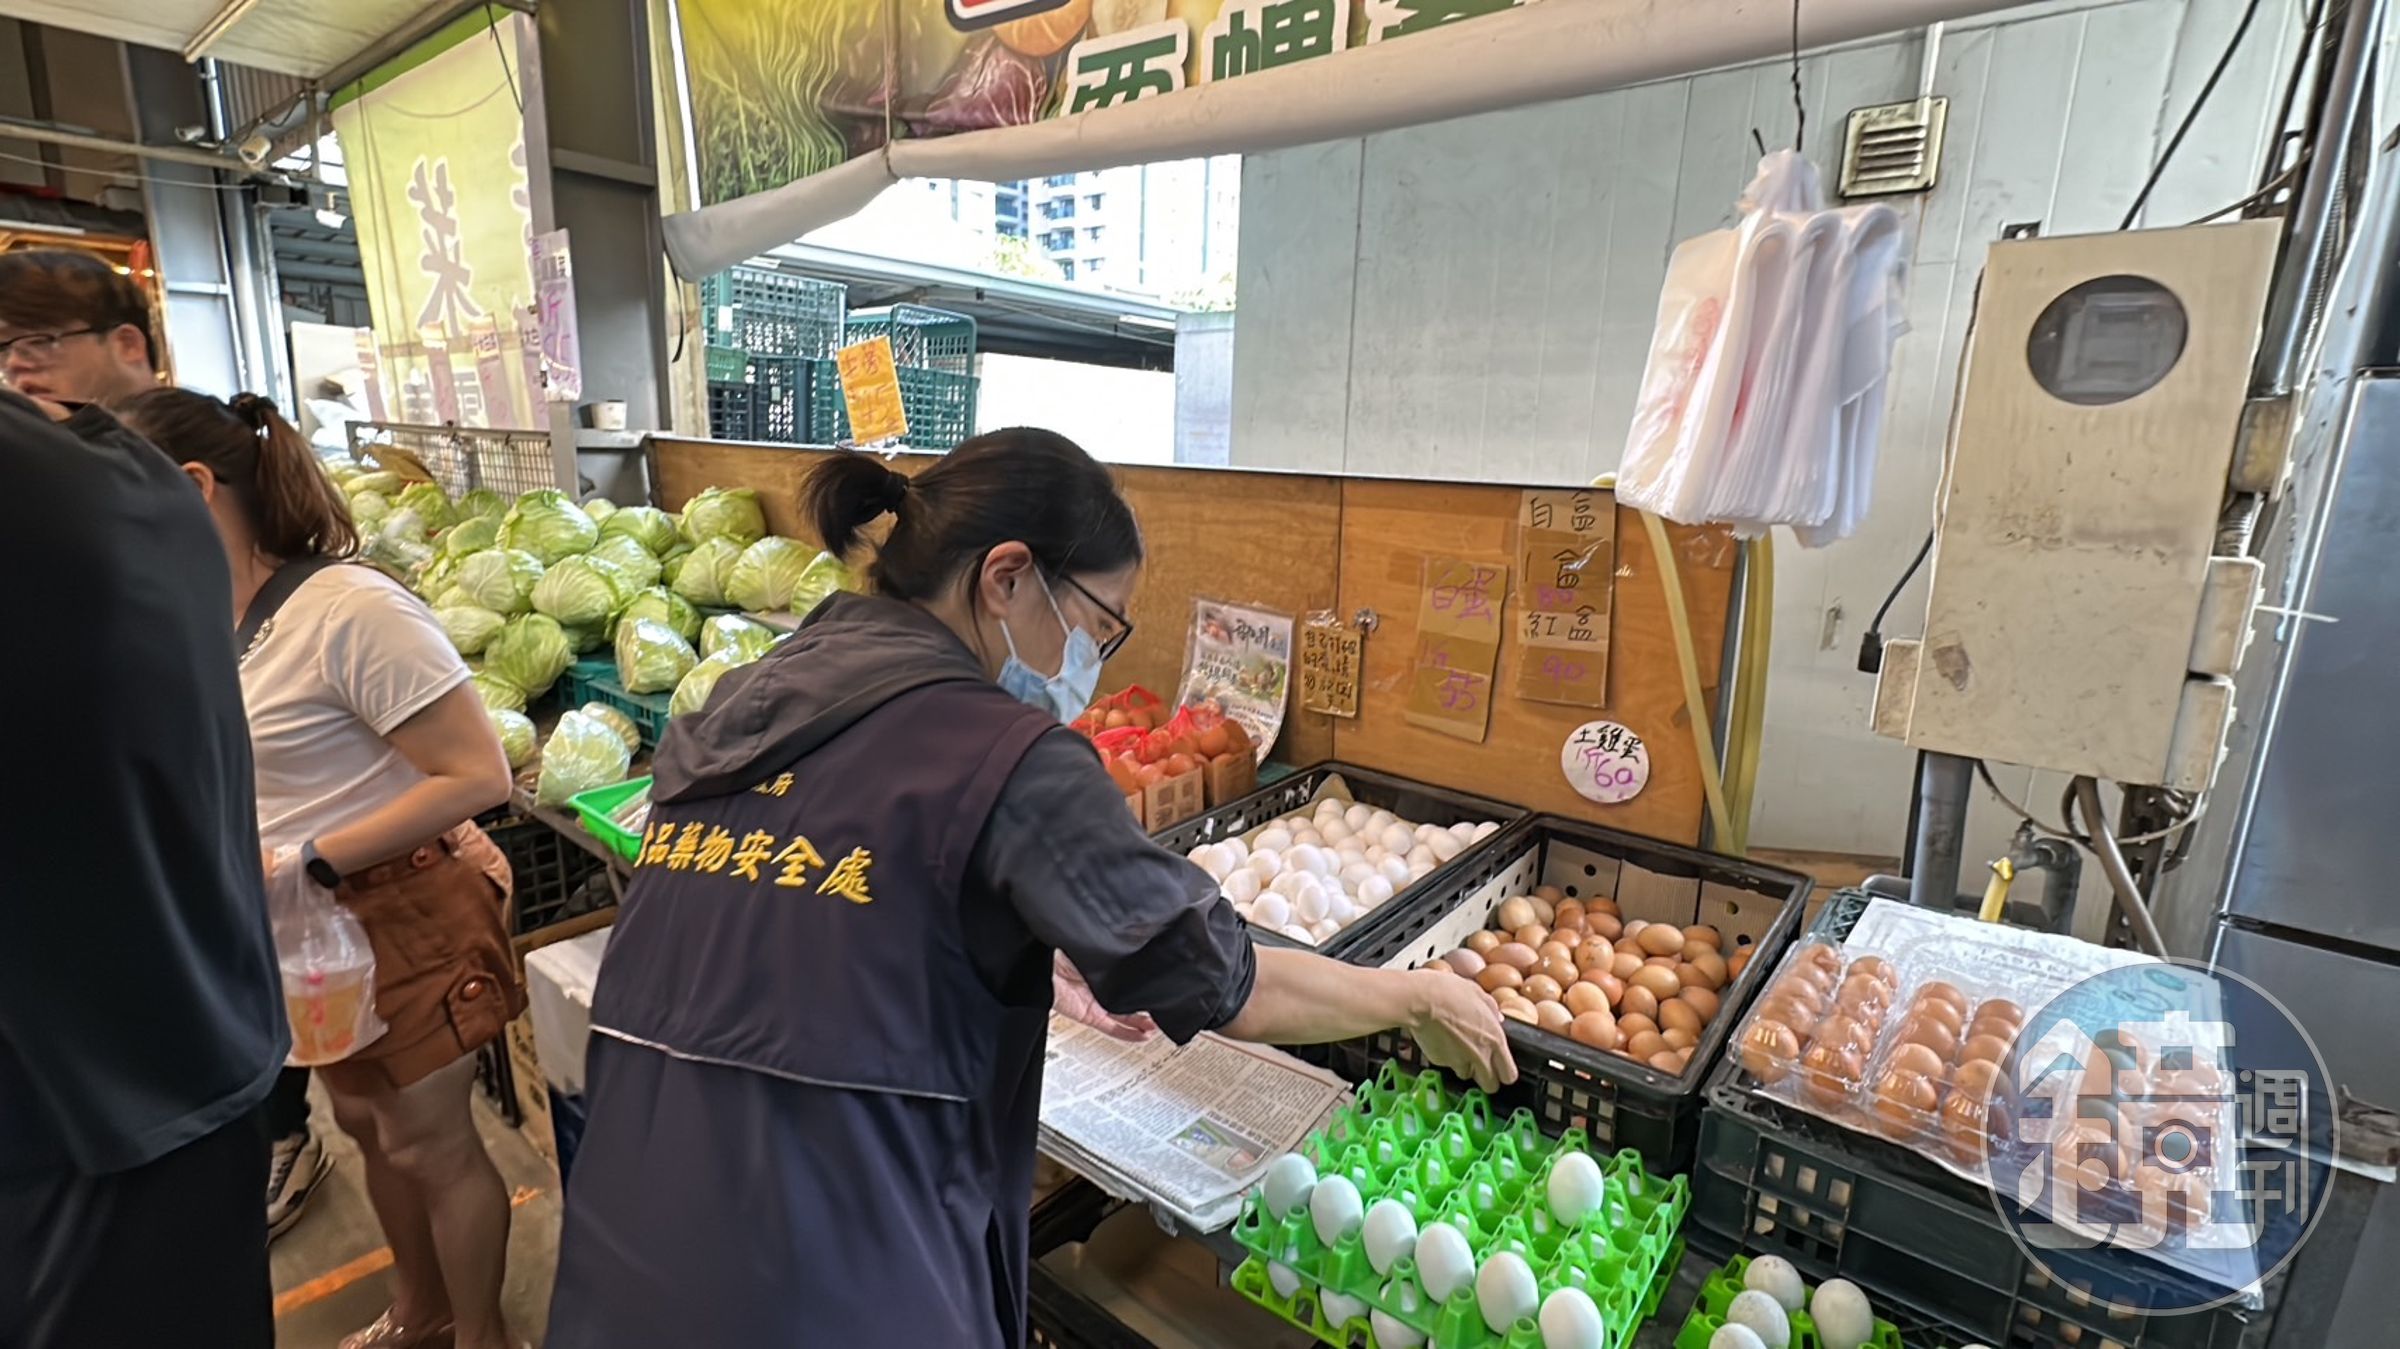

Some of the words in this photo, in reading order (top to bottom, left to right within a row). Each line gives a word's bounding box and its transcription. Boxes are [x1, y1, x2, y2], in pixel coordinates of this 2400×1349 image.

[1432, 568, 1497, 625] 白蛋
[1573, 724, 1642, 764] 土雞蛋
[1593, 758, 1634, 788] 60
